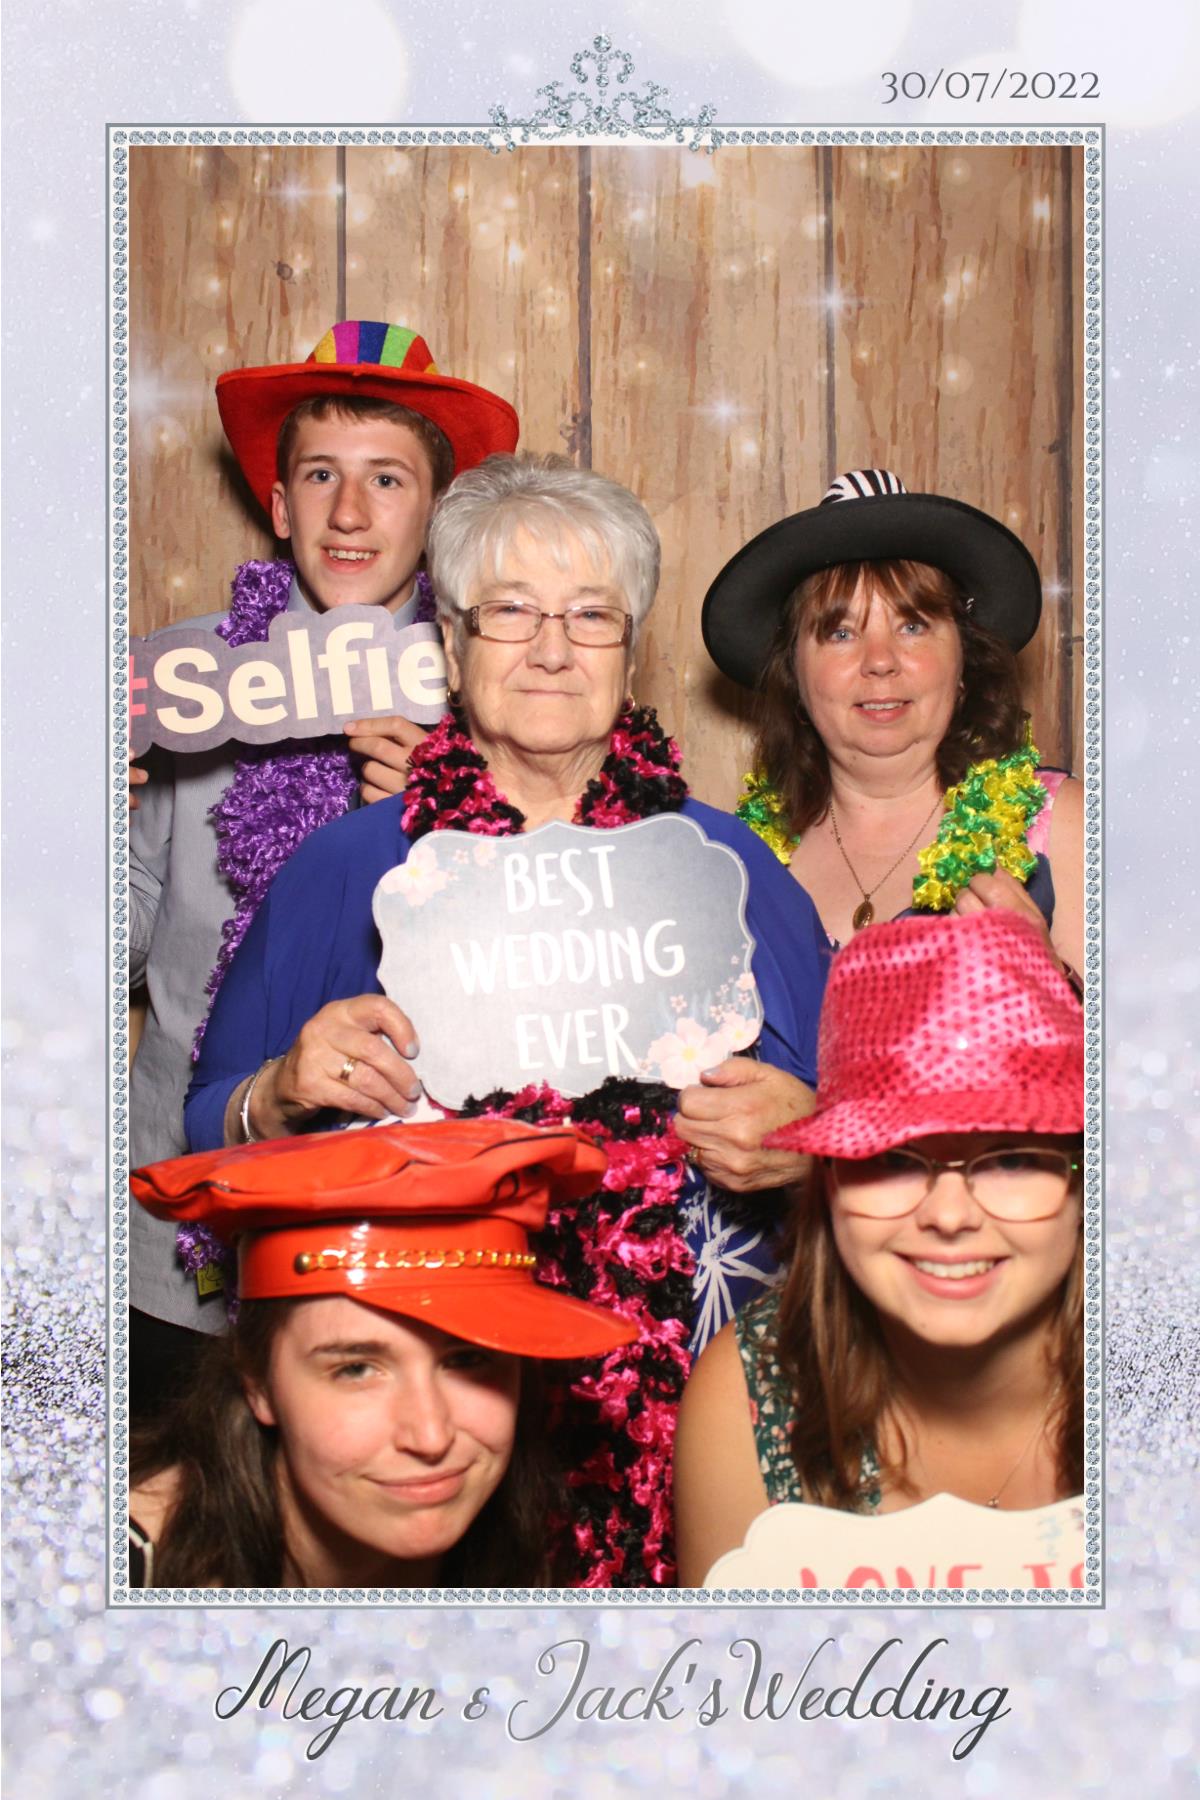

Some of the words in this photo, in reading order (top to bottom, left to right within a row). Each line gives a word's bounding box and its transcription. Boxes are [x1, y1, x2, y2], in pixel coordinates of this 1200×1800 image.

[503, 845, 616, 916] BEST
[449, 919, 686, 995] WEDDING
[514, 1003, 640, 1075] EVER
